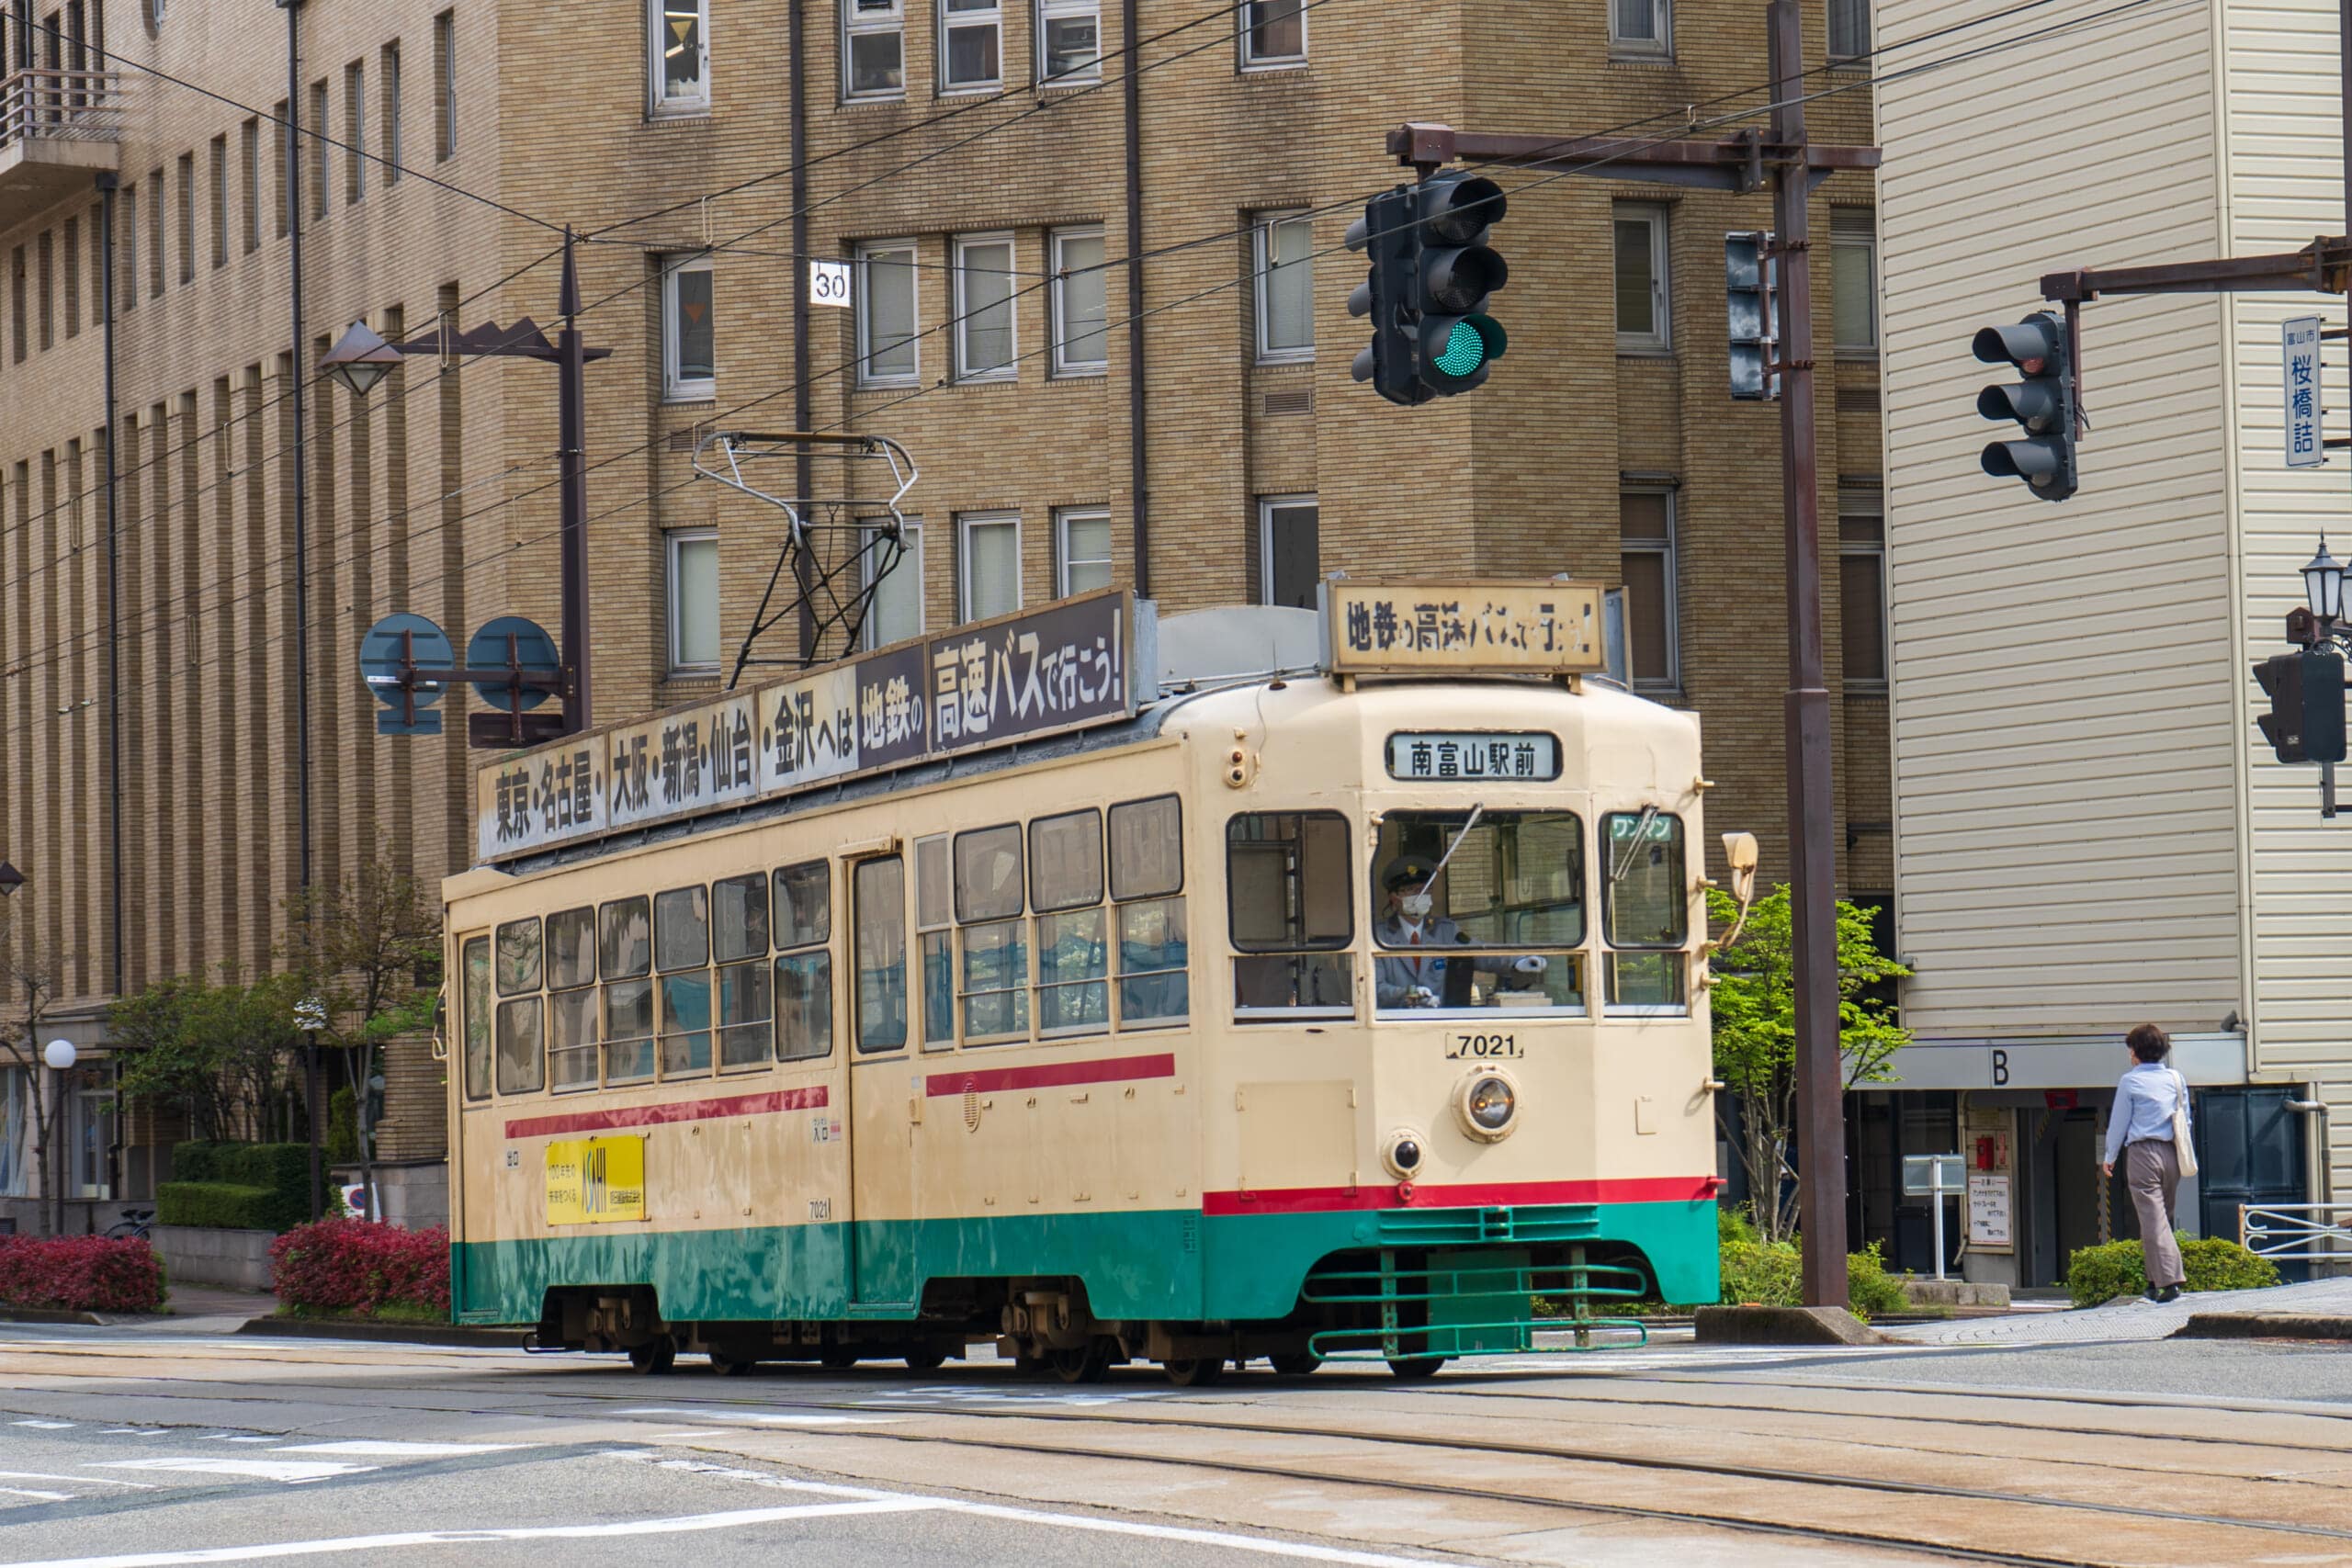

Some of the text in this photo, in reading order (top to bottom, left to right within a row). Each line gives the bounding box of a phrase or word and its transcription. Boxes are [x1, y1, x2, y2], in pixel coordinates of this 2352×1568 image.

[816, 272, 845, 299] 30
[2287, 330, 2315, 346] 富山市
[2291, 354, 2313, 454] 桜橋詰
[1410, 740, 1535, 776] 南富山駅前
[1457, 1034, 1514, 1056] 7021
[1992, 1049, 2009, 1086] B
[813, 1127, 829, 1144] 入口
[809, 1200, 828, 1220] 7021
